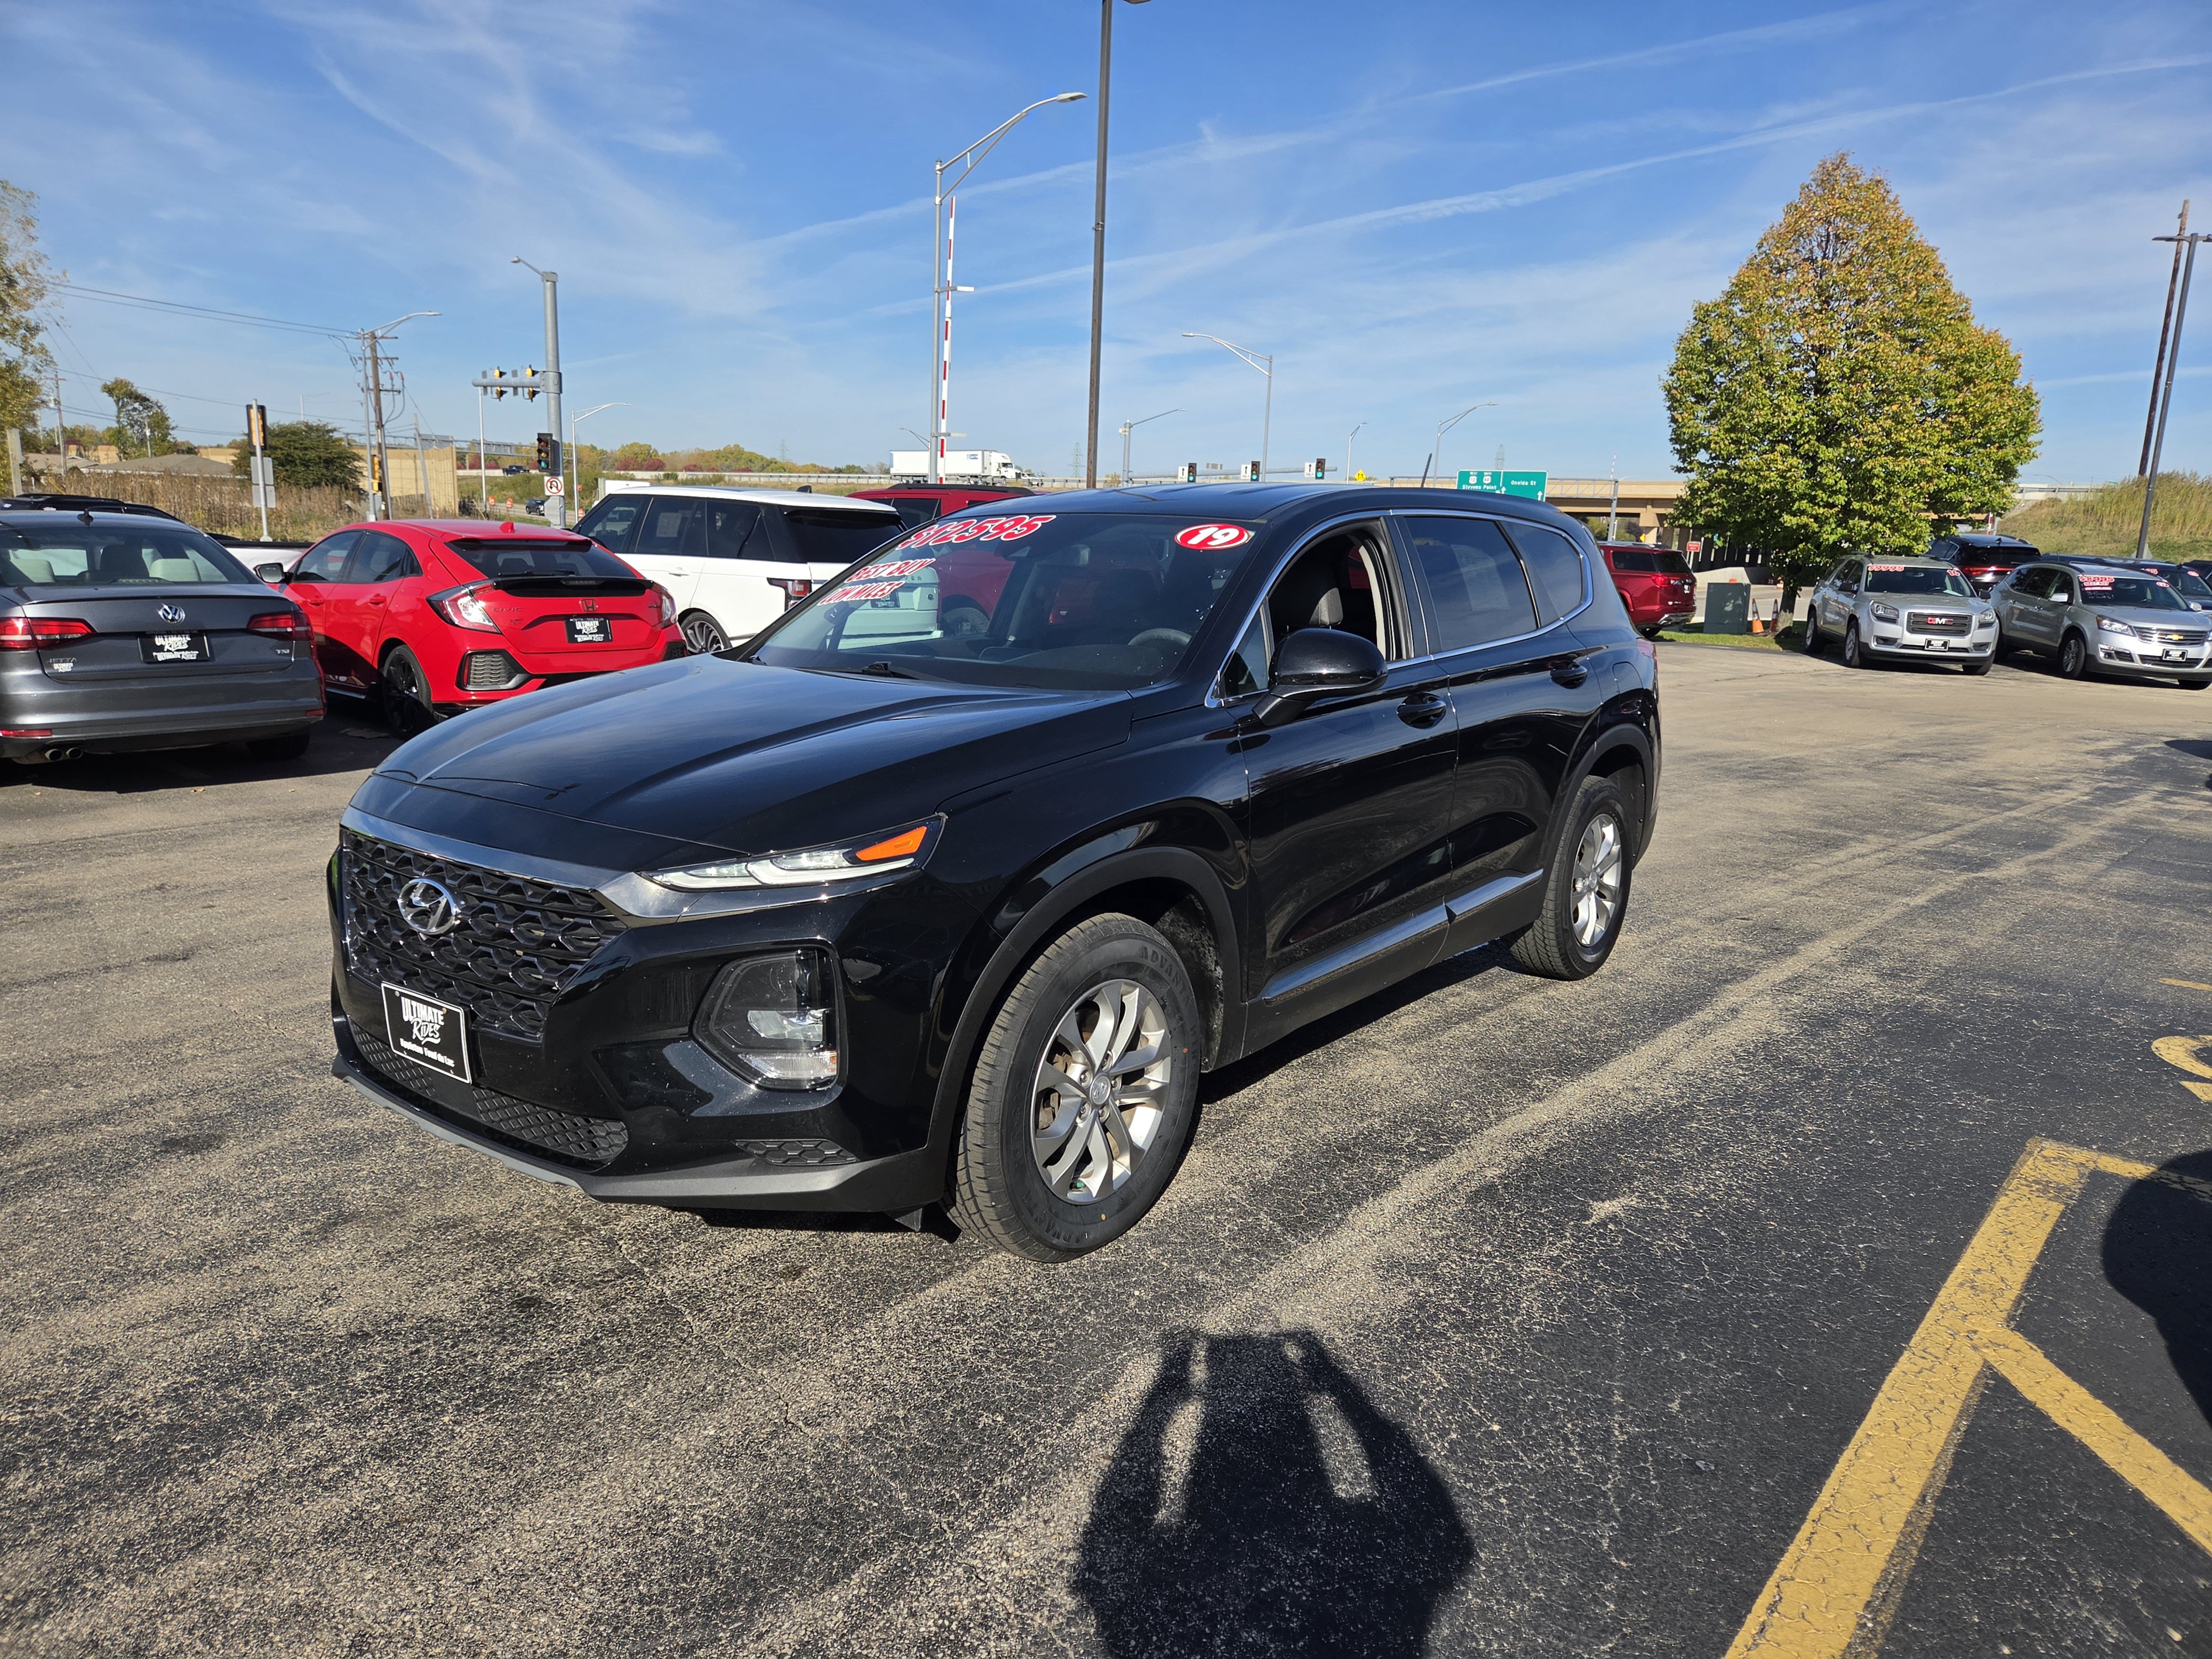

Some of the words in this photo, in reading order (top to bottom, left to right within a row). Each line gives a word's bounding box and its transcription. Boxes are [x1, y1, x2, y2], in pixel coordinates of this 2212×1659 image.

[895, 515, 1056, 550] $12595
[1187, 527, 1239, 546] 19
[844, 562, 900, 583] BEST
[885, 559, 936, 577] BUY
[817, 586, 862, 607] LOW
[843, 581, 905, 601] MILES
[576, 620, 599, 630] ULTIMATE
[582, 626, 597, 634] RIDES
[155, 634, 191, 646] ULTIMATE
[164, 640, 188, 651] RIDES
[401, 997, 444, 1026] ULTIMATE
[411, 1018, 441, 1042] RIDES
